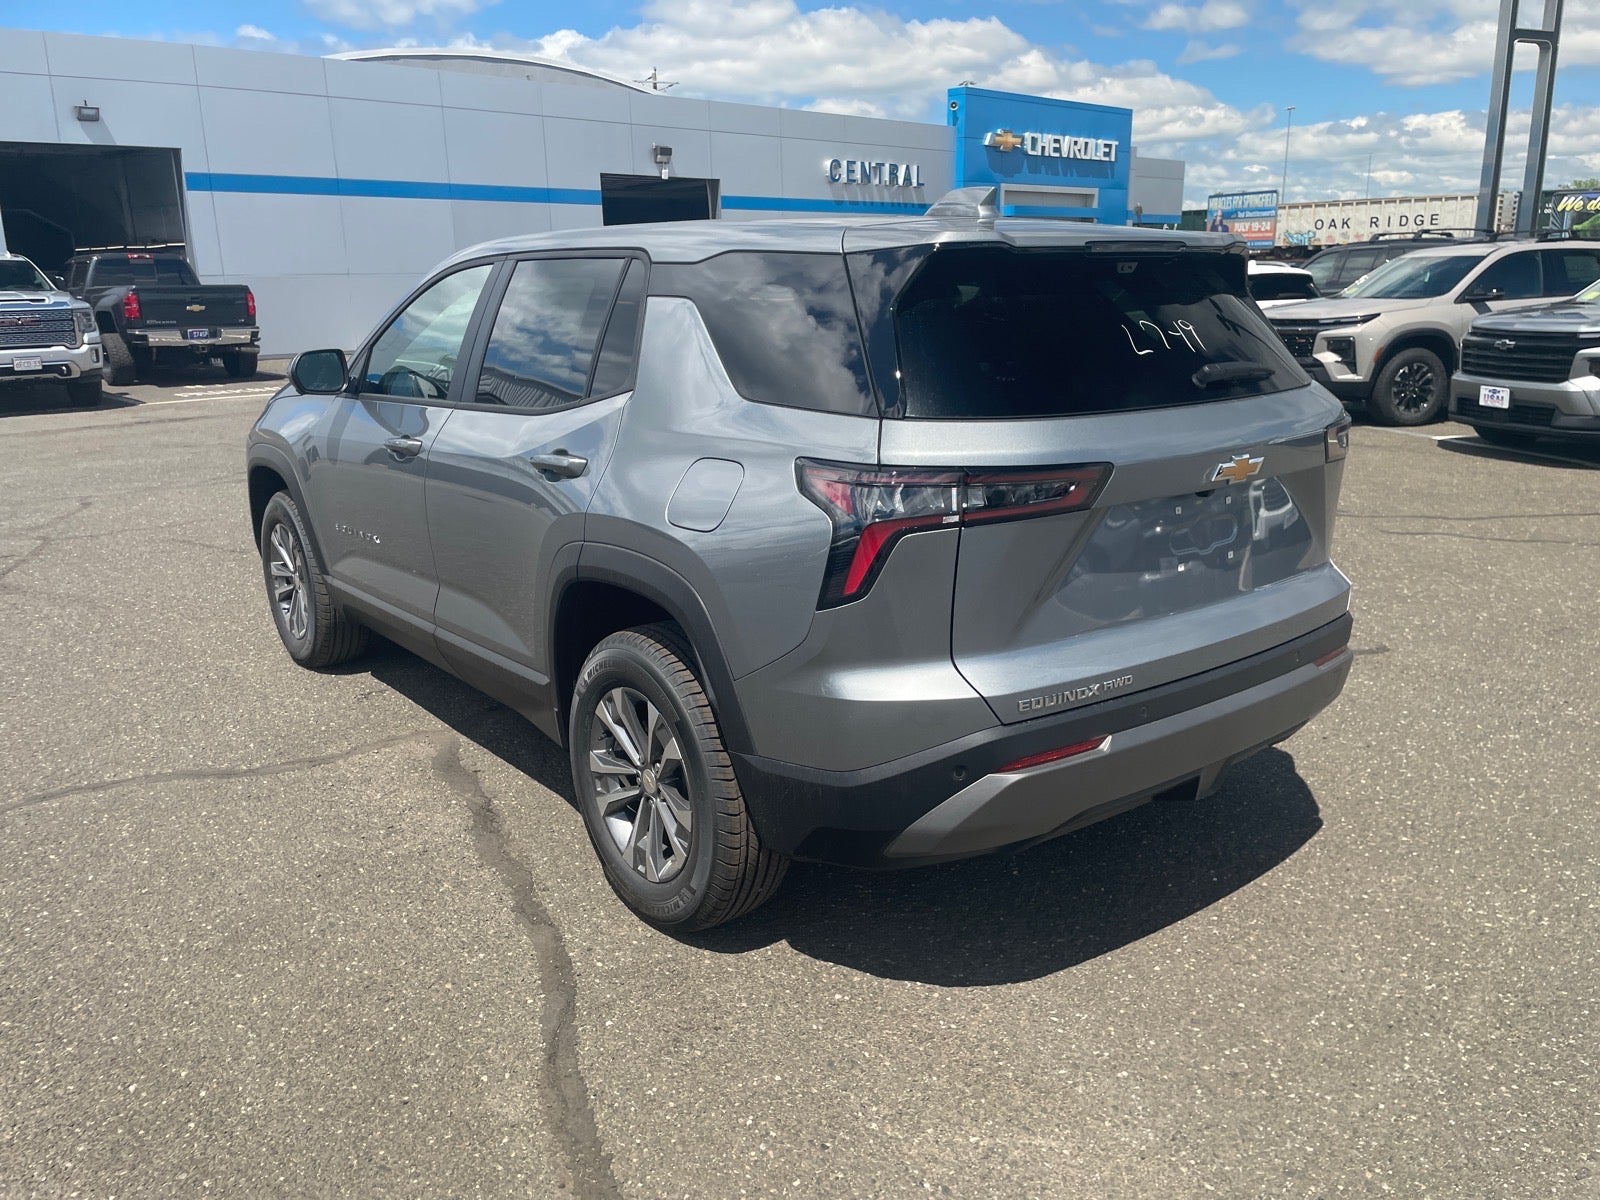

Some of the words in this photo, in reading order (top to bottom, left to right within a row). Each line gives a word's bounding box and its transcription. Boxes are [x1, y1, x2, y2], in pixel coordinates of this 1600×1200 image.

[1024, 131, 1119, 162] CHEVROLET
[826, 158, 925, 188] CENTRAL
[1557, 195, 1583, 212] We
[1233, 222, 1250, 233] JULY
[1251, 221, 1271, 232] 19-24
[1314, 217, 1351, 231] OAK
[1369, 213, 1440, 229] RIDGE
[1018, 683, 1100, 712] EQUINOX
[1103, 675, 1133, 691] AWD
